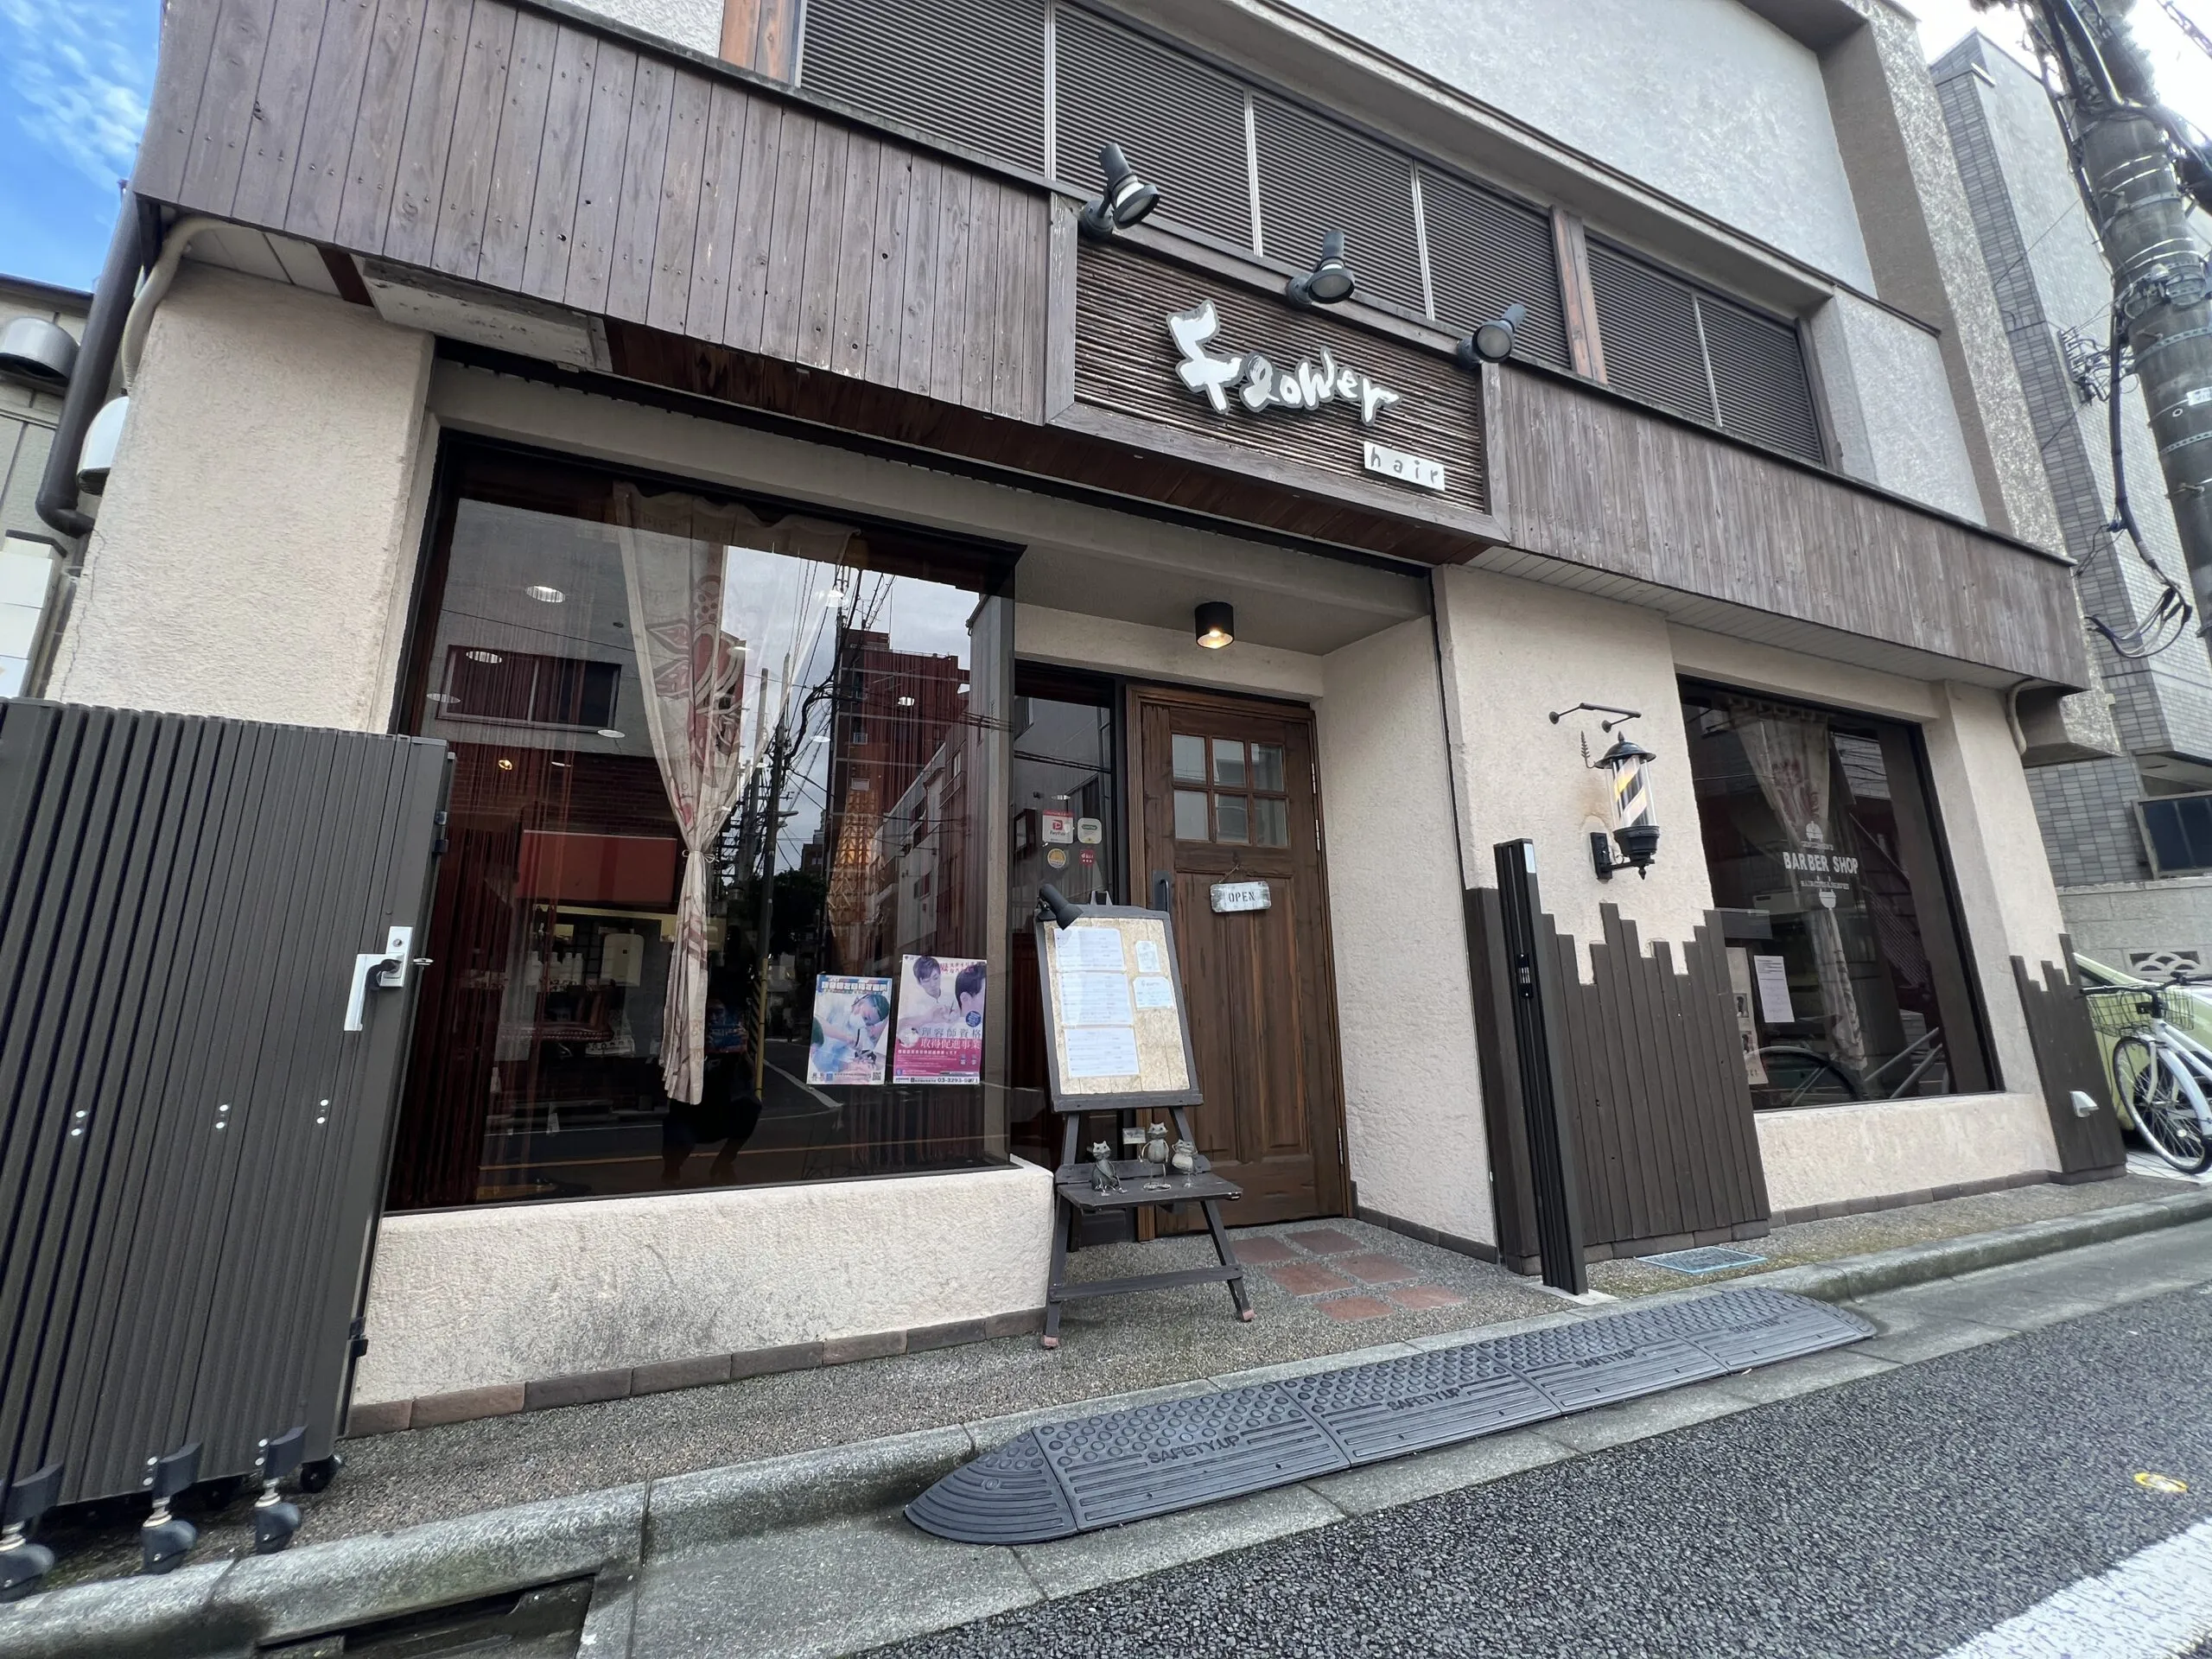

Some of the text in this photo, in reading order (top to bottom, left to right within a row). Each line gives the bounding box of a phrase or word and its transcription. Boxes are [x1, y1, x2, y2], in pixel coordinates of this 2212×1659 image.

[1169, 299, 1401, 425] Flower
[1370, 446, 1440, 485] hair
[1783, 851, 1859, 874] BARBER SHOP
[1228, 891, 1255, 903] OPEN
[921, 1026, 982, 1038] 理容師資格
[920, 1037, 982, 1050] 取得促進事業
